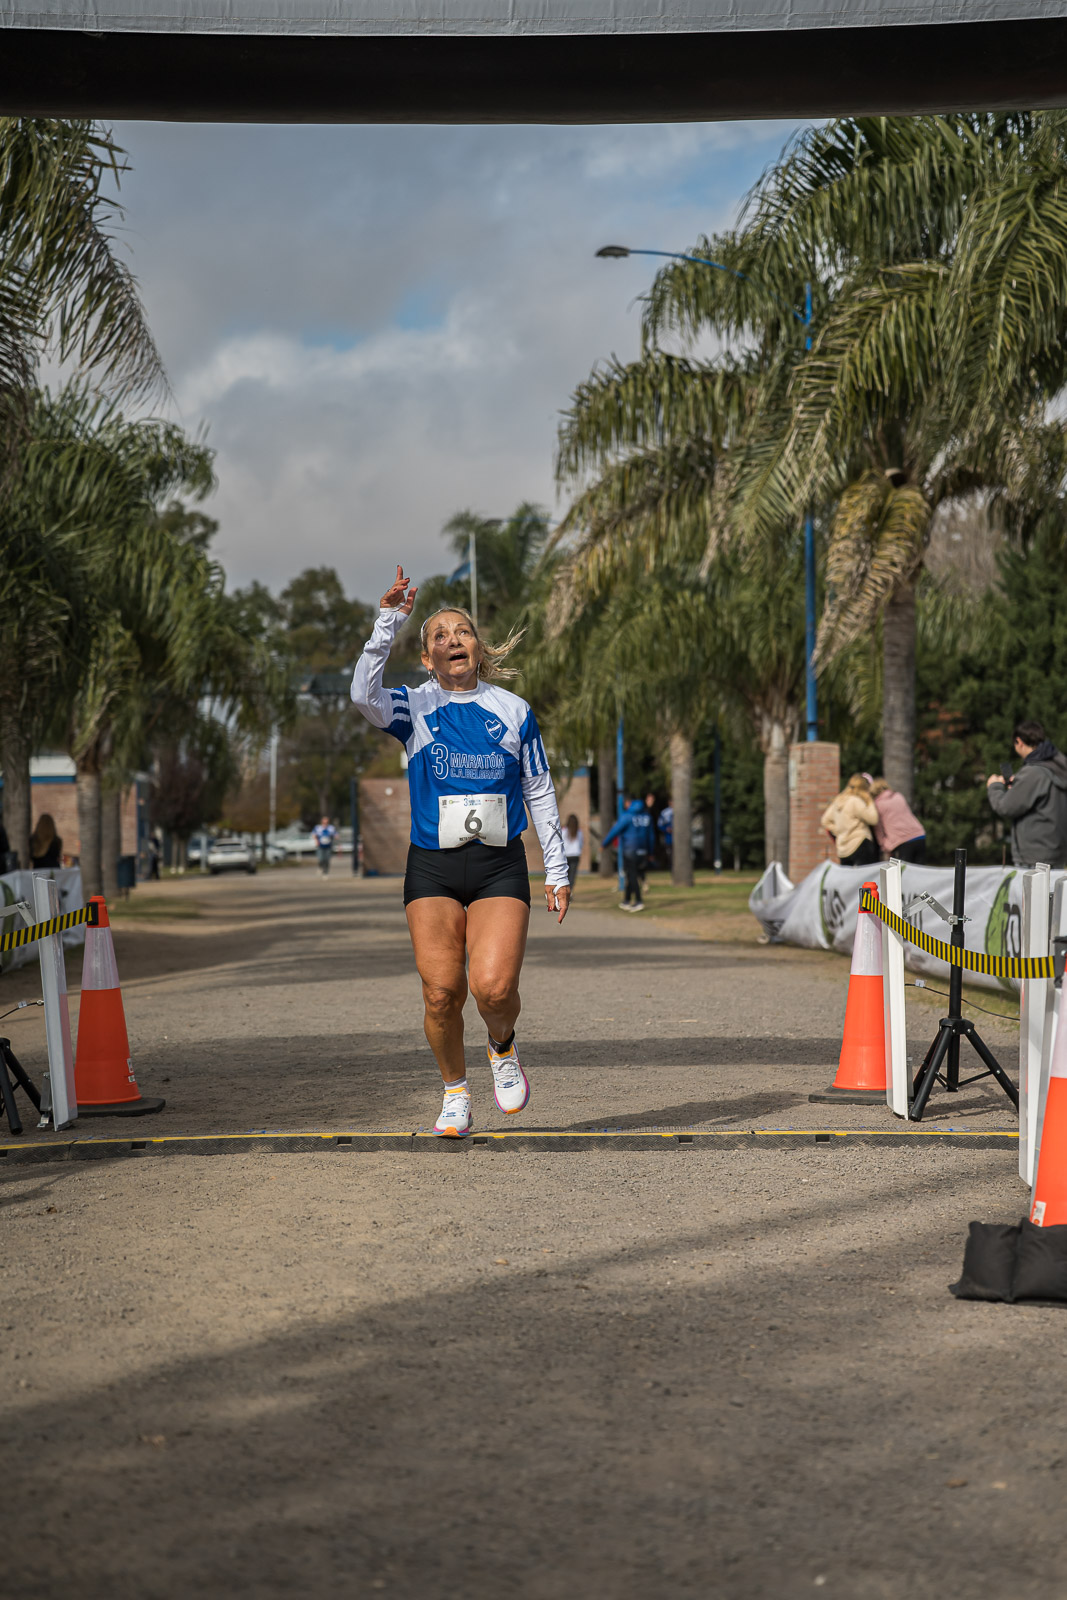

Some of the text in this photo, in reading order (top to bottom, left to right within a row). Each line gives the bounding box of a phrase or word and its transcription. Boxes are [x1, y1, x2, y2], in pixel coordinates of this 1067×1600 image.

[431, 743, 505, 780] 3 MARATÓN
[464, 809, 482, 834] 6
